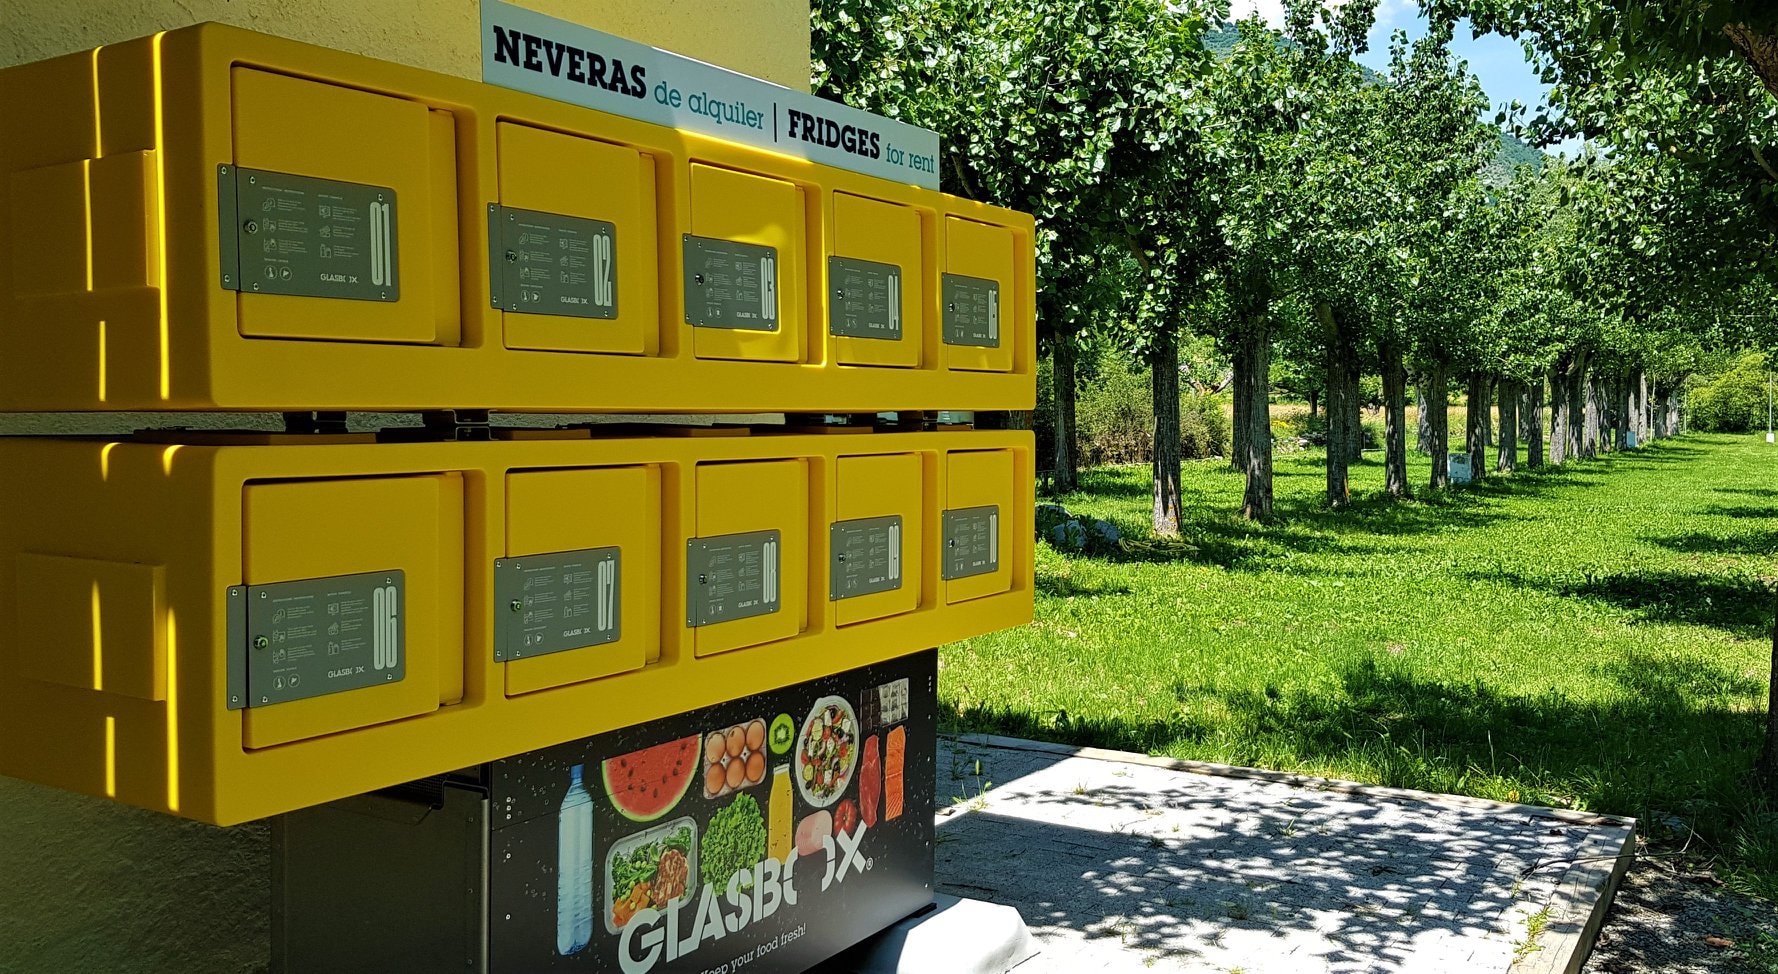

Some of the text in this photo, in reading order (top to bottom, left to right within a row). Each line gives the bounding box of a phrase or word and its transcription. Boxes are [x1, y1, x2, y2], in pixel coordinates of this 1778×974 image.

[493, 25, 764, 130] NEVERAS de alquiler
[788, 108, 935, 174] FRIDGES for rent
[369, 202, 392, 287] 01
[593, 234, 612, 306] 02
[760, 257, 775, 320] 03
[888, 274, 899, 331] 04
[763, 541, 776, 604] 08
[888, 525, 899, 580] 09
[373, 585, 398, 671] 06
[597, 560, 615, 632] 07
[730, 950, 755, 974] your
[756, 936, 779, 958] food
[780, 922, 806, 946] fresh!
